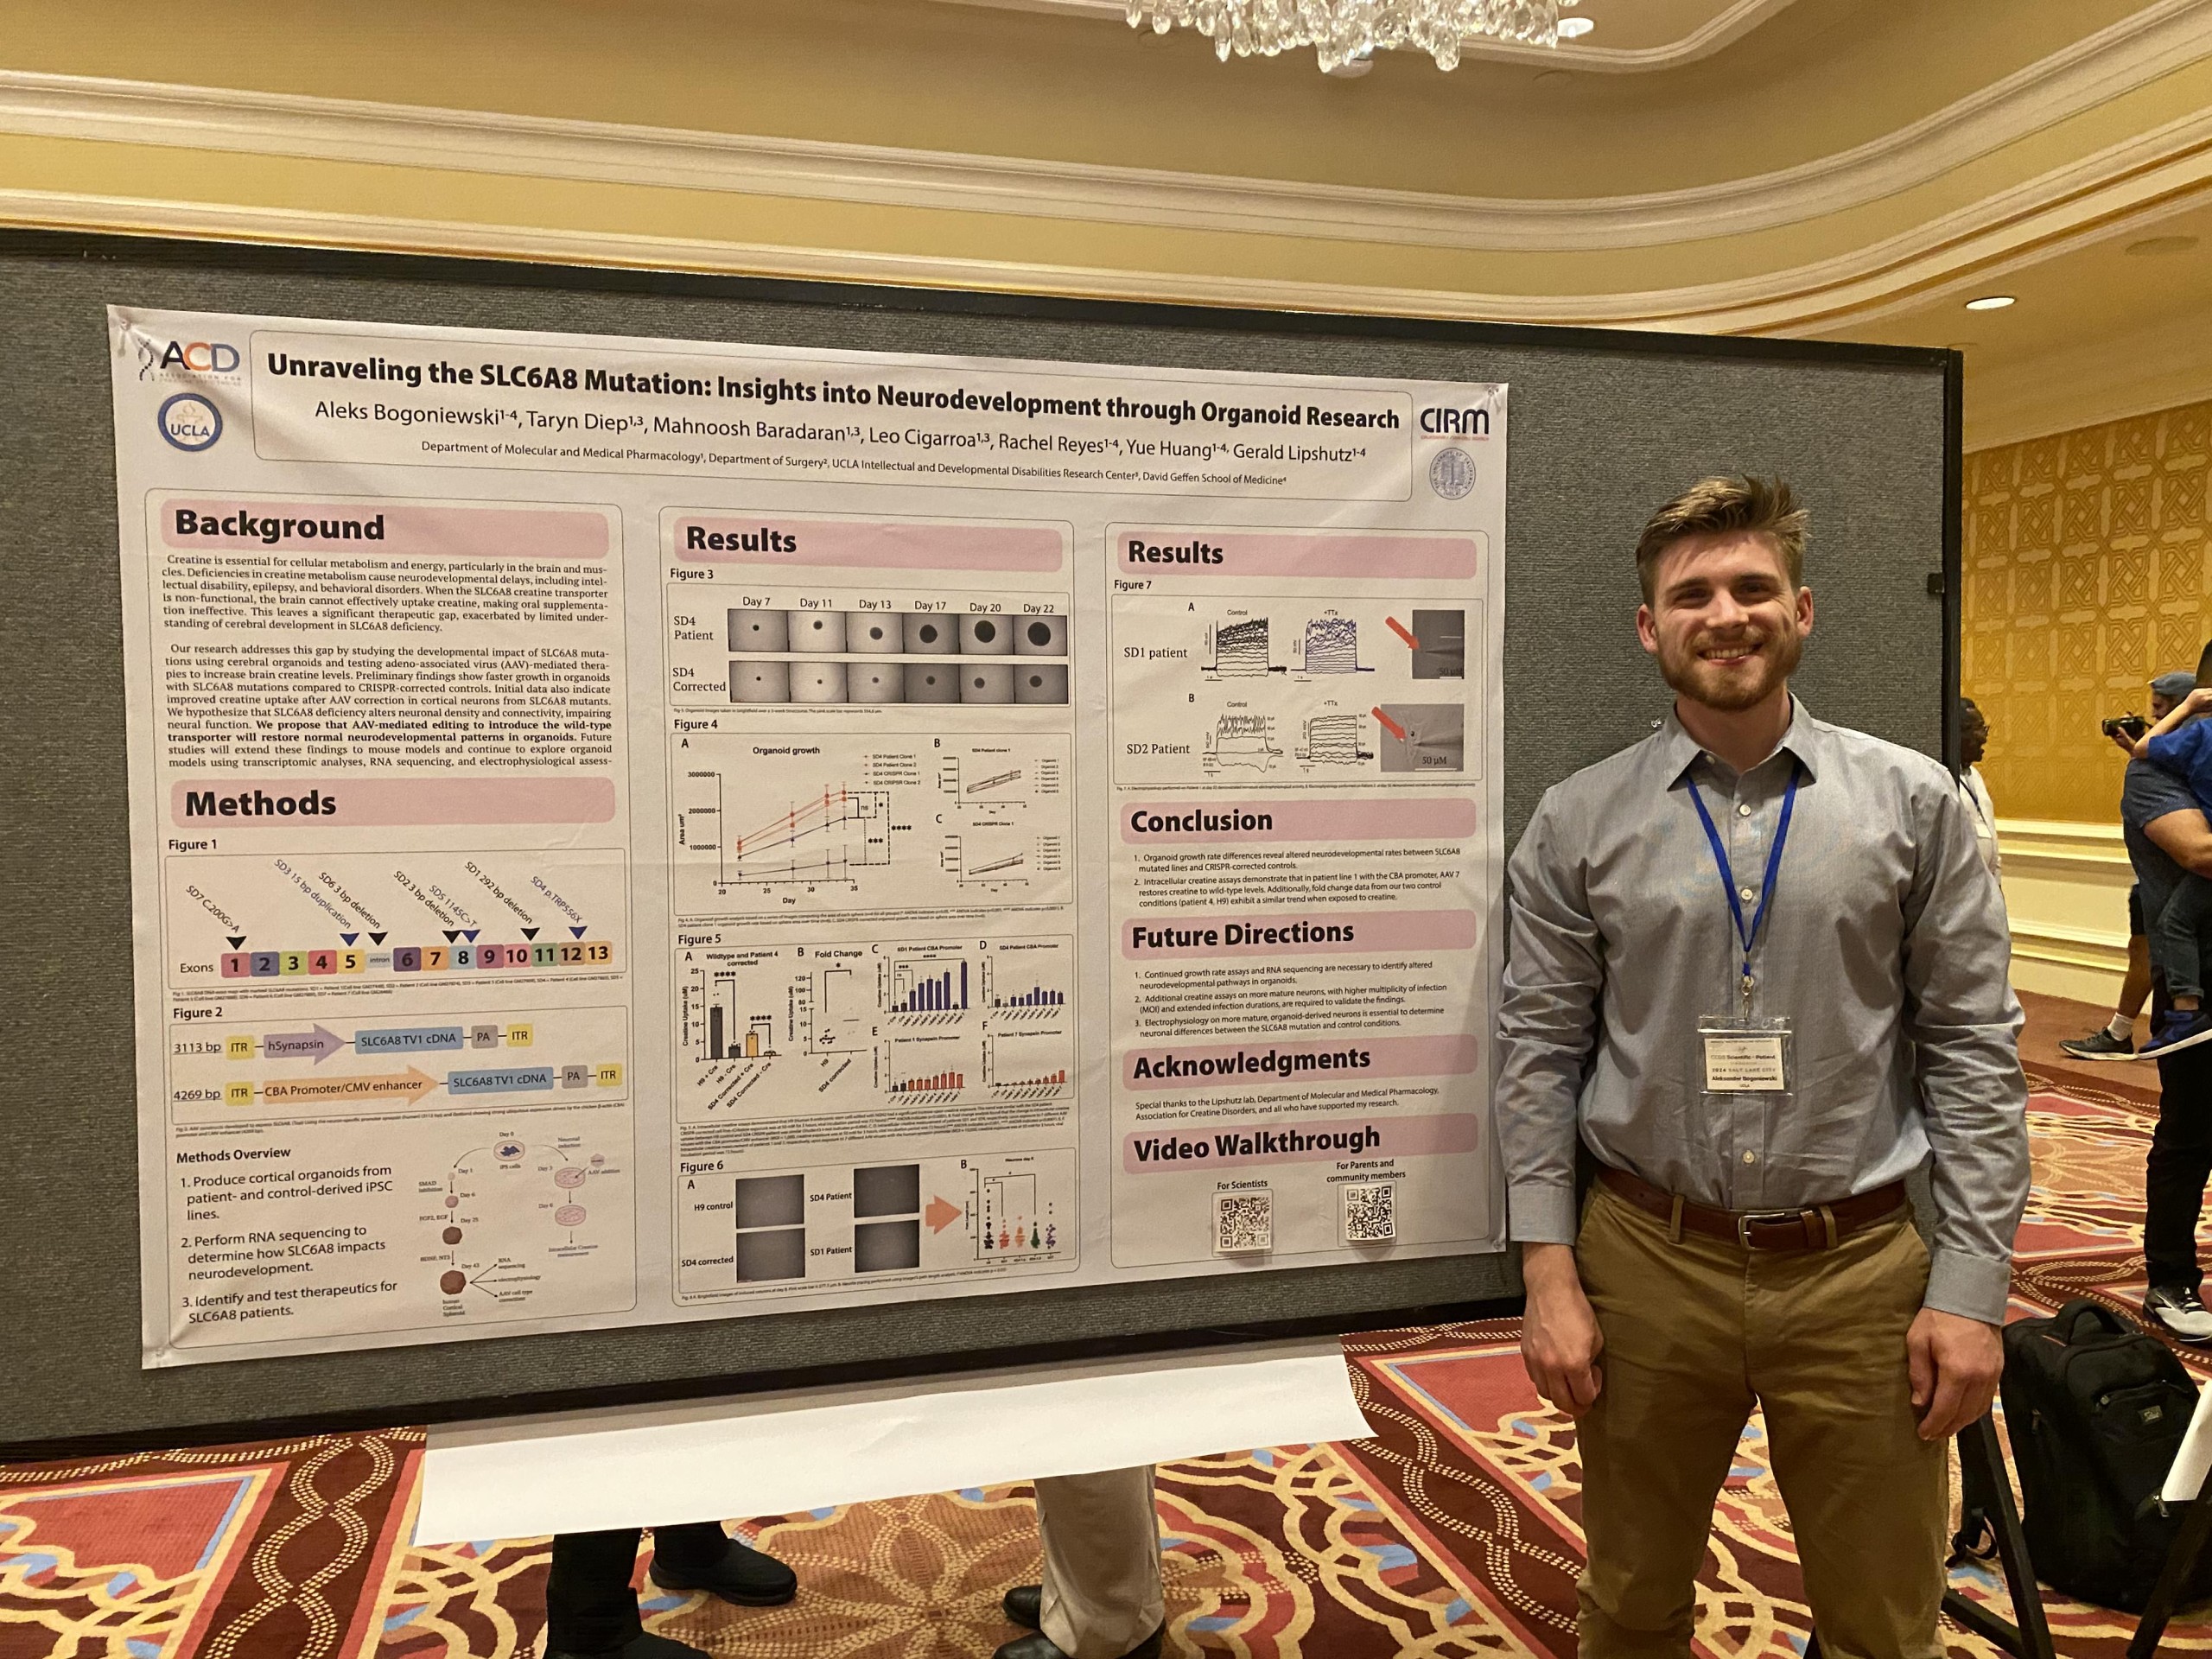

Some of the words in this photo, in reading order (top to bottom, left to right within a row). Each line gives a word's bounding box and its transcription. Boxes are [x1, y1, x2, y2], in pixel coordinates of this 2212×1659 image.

[160, 341, 239, 372] ACD
[268, 353, 421, 388] Unraveling
[428, 360, 473, 385] the
[480, 364, 577, 390] SLC6A8
[585, 369, 710, 396] Mutation:
[718, 375, 816, 405] Insights
[823, 380, 871, 404] into
[878, 384, 1101, 418] Neurodevelopment
[1106, 396, 1195, 425] through
[1201, 401, 1300, 428] Organoid
[1306, 406, 1398, 429] Research
[1421, 408, 1489, 435] CIRM
[170, 424, 210, 436] UCLA
[422, 441, 487, 454] Department
[491, 442, 501, 454] of
[505, 443, 557, 455] Molecular
[560, 446, 579, 457] and
[582, 447, 623, 459] Medical
[709, 453, 770, 465] Department
[772, 455, 783, 465] of
[832, 458, 859, 468] UCLA
[861, 460, 914, 471] Intellectual
[918, 462, 935, 472] and
[938, 463, 1008, 475] Developmental
[1012, 466, 1061, 477] Disabilities
[1063, 468, 1103, 479] Research
[1142, 471, 1167, 481] David
[1170, 472, 1199, 482] Geffen
[1201, 473, 1230, 483] School
[1232, 474, 1242, 483] of
[176, 509, 384, 544] Background
[687, 525, 796, 553] Results
[1128, 540, 1223, 564] Results
[168, 555, 211, 564] Creatine
[214, 556, 222, 565] is
[225, 556, 270, 566] essential
[273, 556, 287, 566] for
[290, 557, 327, 567] cellular
[330, 559, 387, 569] metabolism
[391, 560, 408, 569] and
[411, 563, 446, 572] energy,
[448, 562, 504, 573] particularly
[506, 563, 515, 571] in
[518, 563, 533, 572] the
[536, 563, 560, 573] brain
[563, 564, 581, 573] and
[671, 568, 704, 581] Figure
[708, 569, 713, 579] 3
[1115, 579, 1143, 591] Figure
[1146, 580, 1151, 589] 7
[743, 596, 761, 607] Day
[765, 597, 770, 606] 7
[800, 598, 818, 609] Day
[823, 599, 831, 607] 11
[859, 599, 877, 611] Day
[880, 600, 891, 609] 13
[914, 601, 932, 612] Day
[936, 601, 945, 610] 17
[969, 602, 987, 613] Day
[988, 603, 1001, 613] 20
[1023, 603, 1040, 614] Day
[1044, 604, 1053, 613] 22
[674, 615, 695, 626] SD4
[674, 630, 713, 640] Patient
[1124, 646, 1144, 658] SD1
[1149, 647, 1187, 660] patient
[672, 667, 694, 677] SD4
[673, 681, 726, 691] Corrected
[674, 719, 708, 732] Figure
[711, 719, 717, 728] 4
[1127, 743, 1147, 754] SD2
[1152, 743, 1189, 753] Patient
[186, 789, 335, 817] Methods
[1131, 808, 1272, 832] Conclusion
[168, 839, 207, 852] Figure
[212, 839, 216, 849] 1
[1143, 853, 1177, 863] Organoid
[1179, 853, 1205, 862] growth
[1222, 851, 1261, 860] differences
[1312, 849, 1383, 858] neurodevelopmental
[1434, 847, 1459, 855] SLC6A8
[678, 934, 712, 947] Figure
[715, 933, 721, 944] 5
[1133, 926, 1217, 949] Future
[1225, 920, 1353, 945] Directions
[180, 963, 213, 973] Exons
[174, 1007, 212, 1020] Figure
[215, 1007, 222, 1017] 2
[361, 1035, 401, 1046] SLC6A8
[403, 1034, 421, 1045] TV1
[426, 1033, 455, 1044] cDNA
[477, 1033, 490, 1042] PA
[512, 1031, 528, 1041] ITR
[175, 1042, 201, 1053] 3113
[203, 1042, 221, 1053] bp
[232, 1042, 248, 1052] ITR
[268, 1039, 323, 1052] hSynapsin
[1133, 1048, 1370, 1079] Acknowledgments
[1134, 1136, 1209, 1161] Video
[1214, 1125, 1379, 1156] Walkthrough
[176, 1149, 230, 1163] Methods
[233, 1147, 290, 1160] Overview
[681, 1162, 714, 1174] Figure
[717, 1160, 722, 1170] 6
[1337, 1161, 1348, 1170] For
[1350, 1160, 1377, 1169] Parents
[1379, 1158, 1394, 1167] and
[181, 1177, 190, 1187] 1.
[194, 1174, 245, 1186] Produce
[249, 1170, 294, 1184] cortical
[298, 1166, 359, 1182] organoids
[363, 1165, 391, 1176] from
[1326, 1173, 1369, 1184] community
[1370, 1170, 1406, 1180] members
[1231, 1179, 1267, 1189] Scientists
[187, 1192, 236, 1206] patient-
[240, 1188, 263, 1200] and
[268, 1181, 362, 1198] control-derived
[366, 1180, 392, 1192] iPSC
[810, 1193, 824, 1202] SD4
[706, 1201, 733, 1211] control
[188, 1210, 219, 1220] lines.
[826, 1246, 851, 1255] Patient
[698, 1255, 733, 1266] corrected
